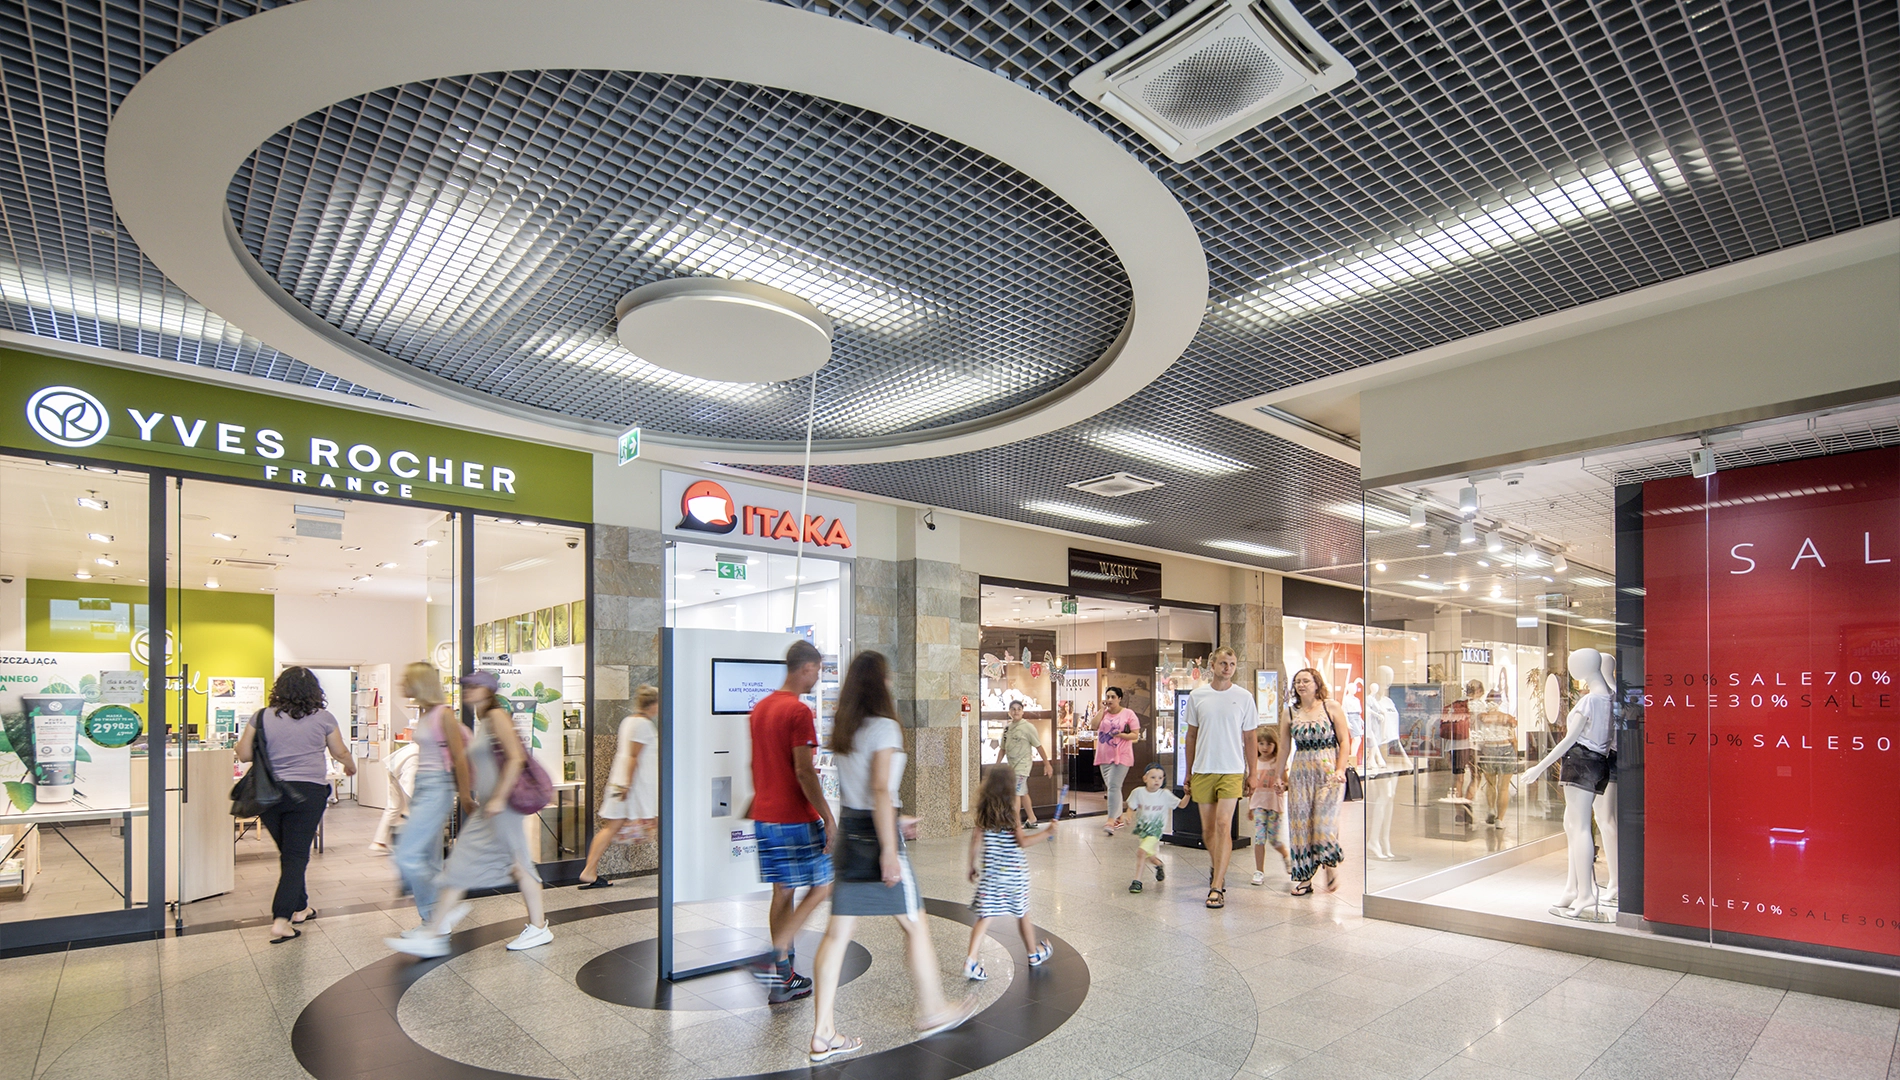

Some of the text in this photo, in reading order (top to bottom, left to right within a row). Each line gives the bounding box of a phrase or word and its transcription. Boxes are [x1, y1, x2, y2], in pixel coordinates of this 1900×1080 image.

[127, 408, 517, 494] YVES ROCHER
[264, 465, 413, 499] FRANCE
[743, 505, 852, 549] ITAKA
